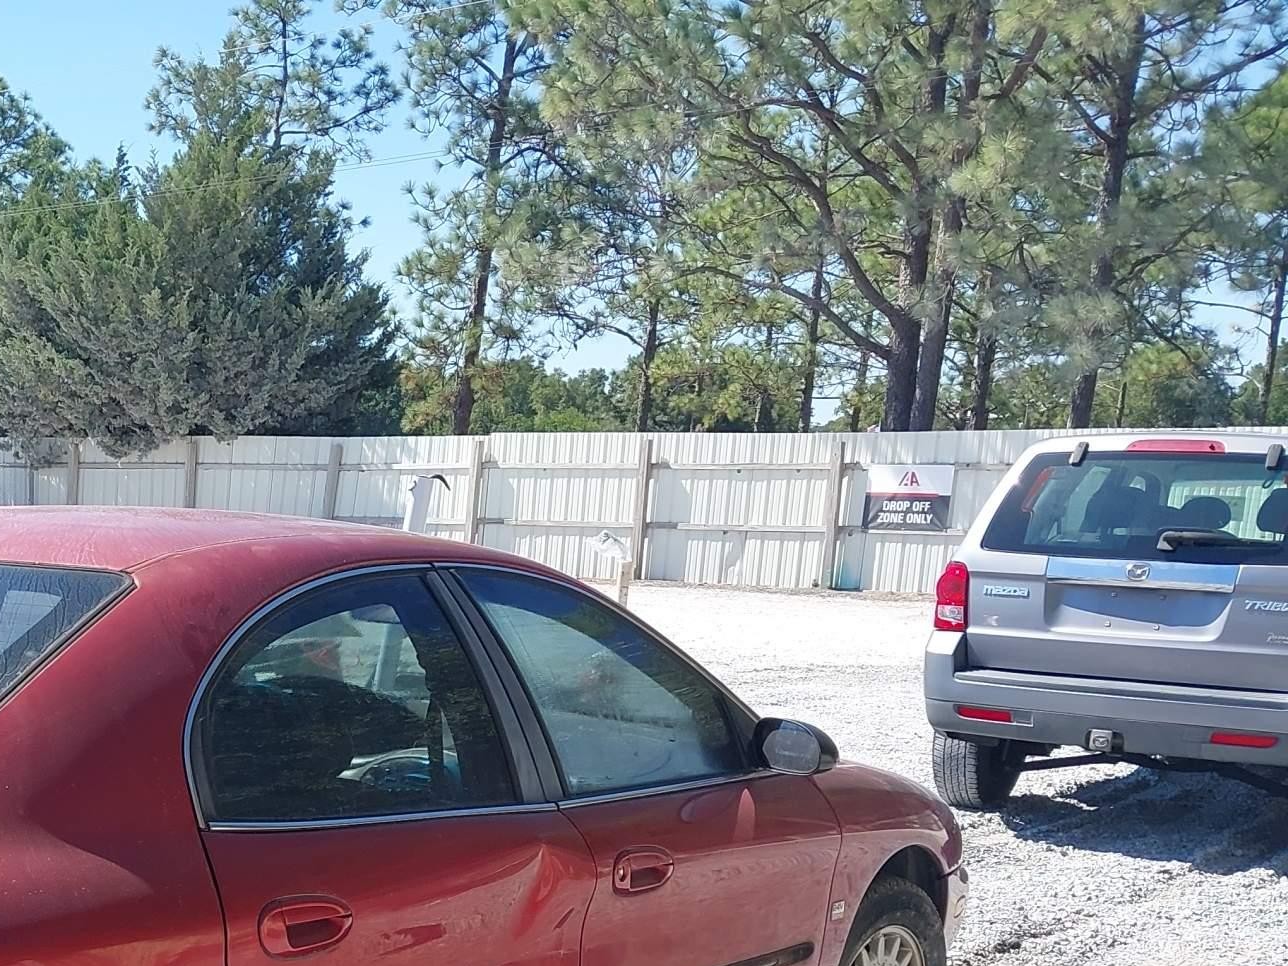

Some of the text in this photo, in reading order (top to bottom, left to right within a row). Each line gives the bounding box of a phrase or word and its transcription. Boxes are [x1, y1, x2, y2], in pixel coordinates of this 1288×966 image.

[882, 500, 932, 512] DROP OFF
[876, 512, 934, 524] ZONE ONLY
